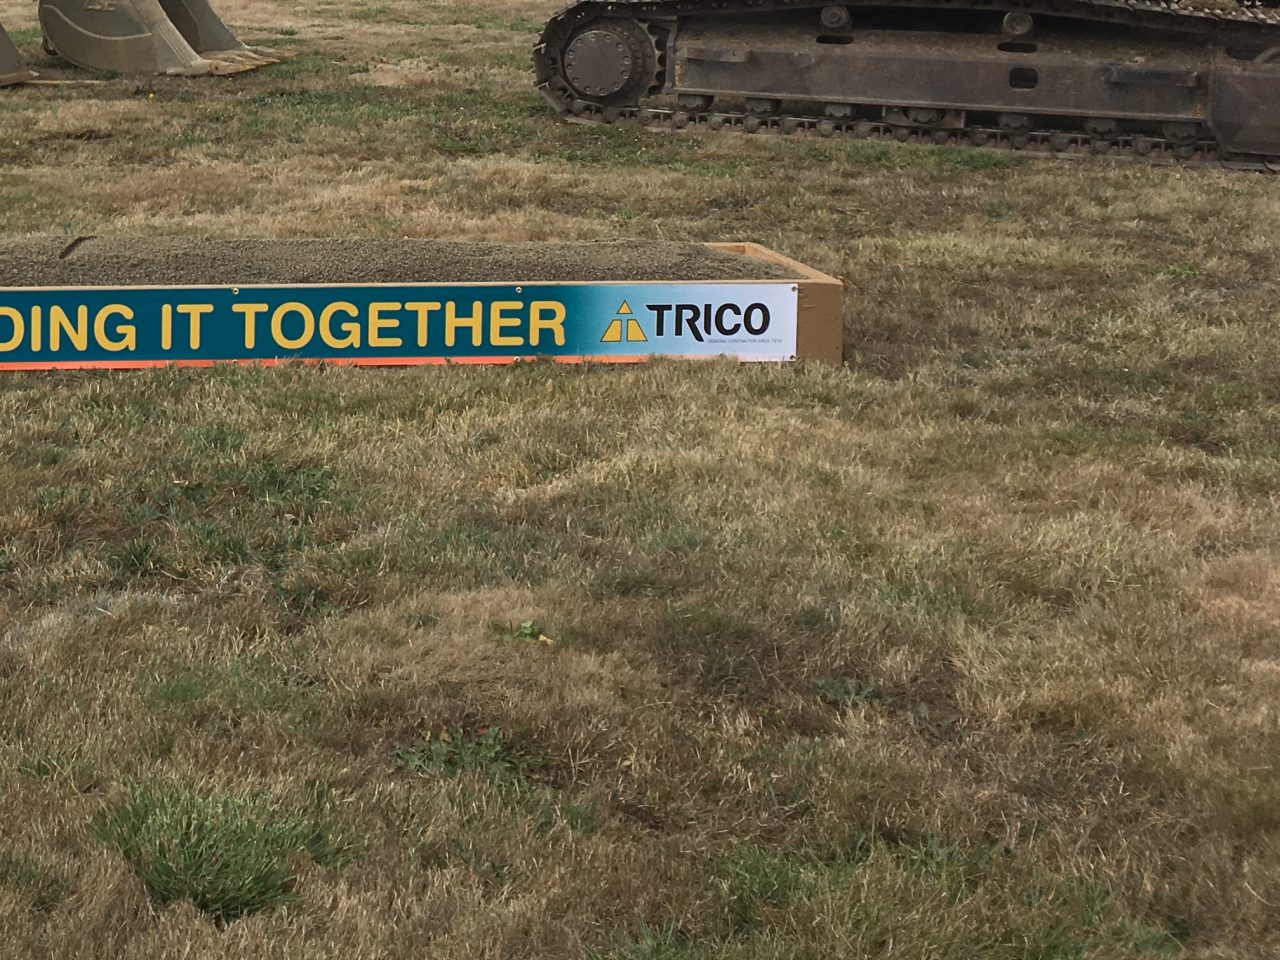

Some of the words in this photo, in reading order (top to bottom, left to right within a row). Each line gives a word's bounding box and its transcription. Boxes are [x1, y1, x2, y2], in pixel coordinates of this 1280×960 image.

[161, 303, 214, 351] IT
[231, 300, 566, 349] TOGETHER
[645, 303, 770, 342] TRICO
